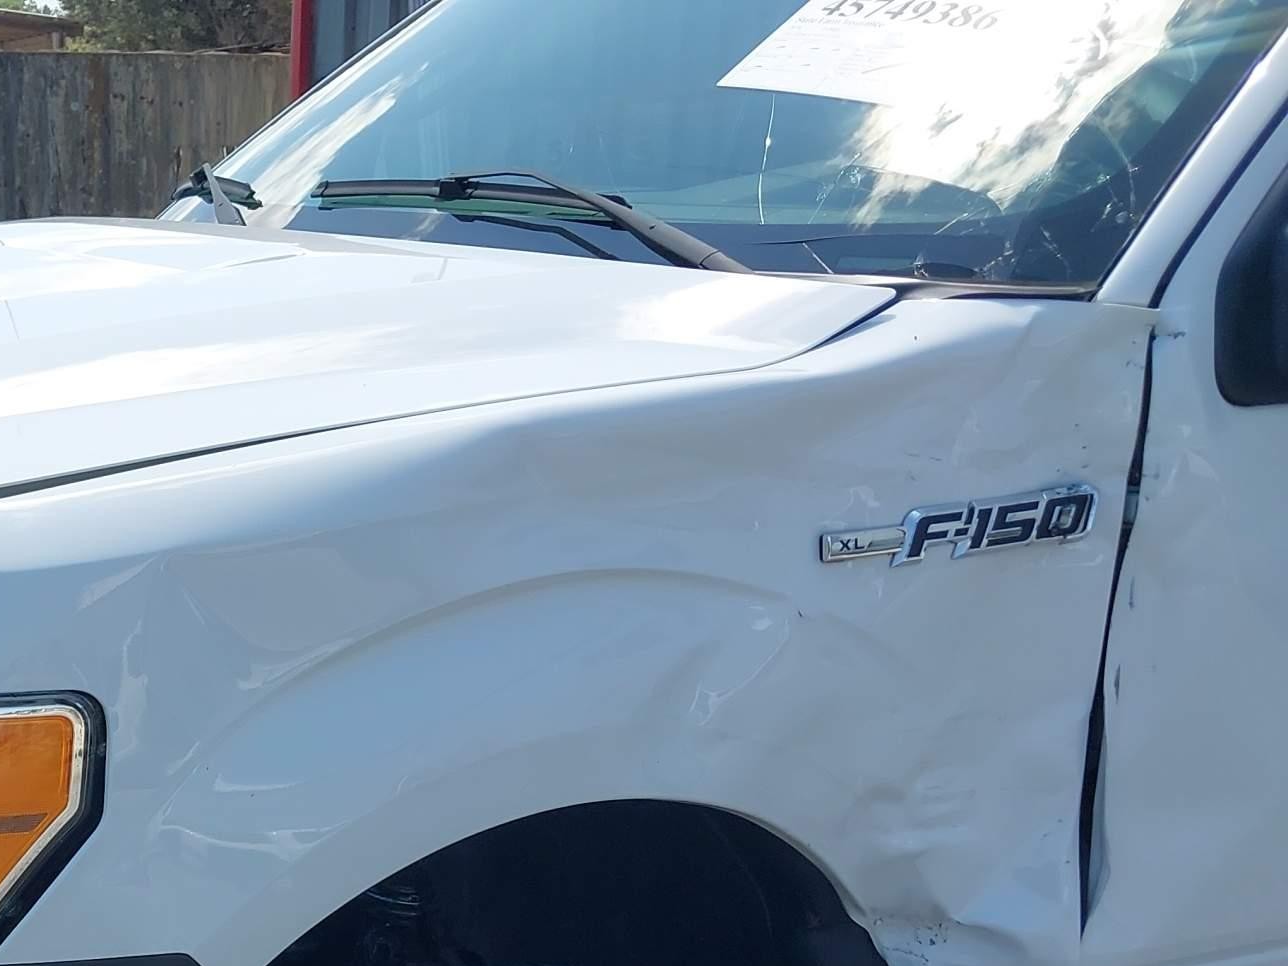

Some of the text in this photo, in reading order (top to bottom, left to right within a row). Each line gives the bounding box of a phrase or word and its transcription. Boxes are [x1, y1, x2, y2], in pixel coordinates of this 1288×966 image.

[820, 0, 1005, 31] 45749386
[838, 488, 1096, 563] XL F-150
